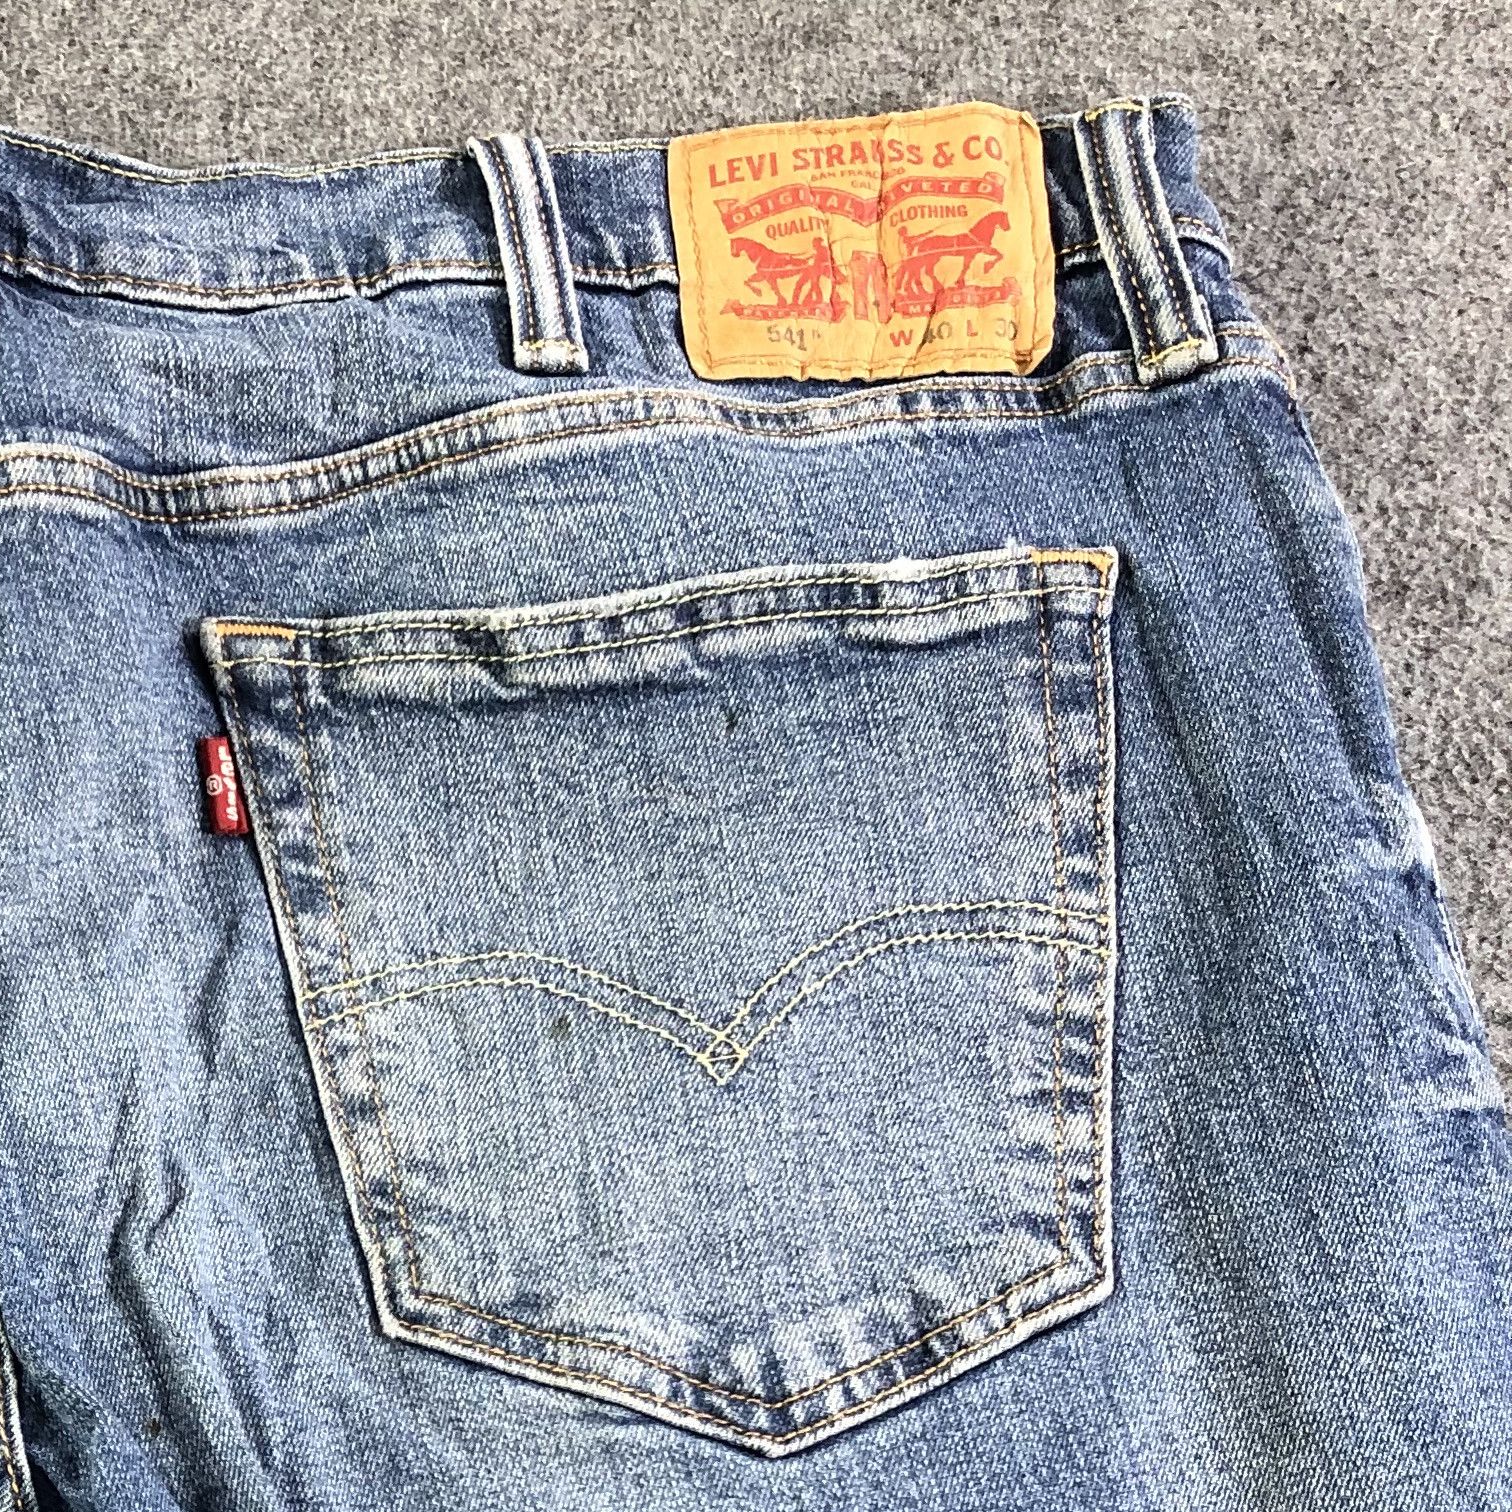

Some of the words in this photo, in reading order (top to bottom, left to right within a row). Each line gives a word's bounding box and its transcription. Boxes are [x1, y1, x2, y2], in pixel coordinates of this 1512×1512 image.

[708, 151, 779, 189] LEVI
[792, 138, 924, 172] STRAUSS
[932, 141, 955, 168] &
[732, 187, 855, 224] ORIGINAL
[890, 204, 969, 227] CLOTHING
[890, 328, 913, 347] W
[967, 319, 979, 337] L
